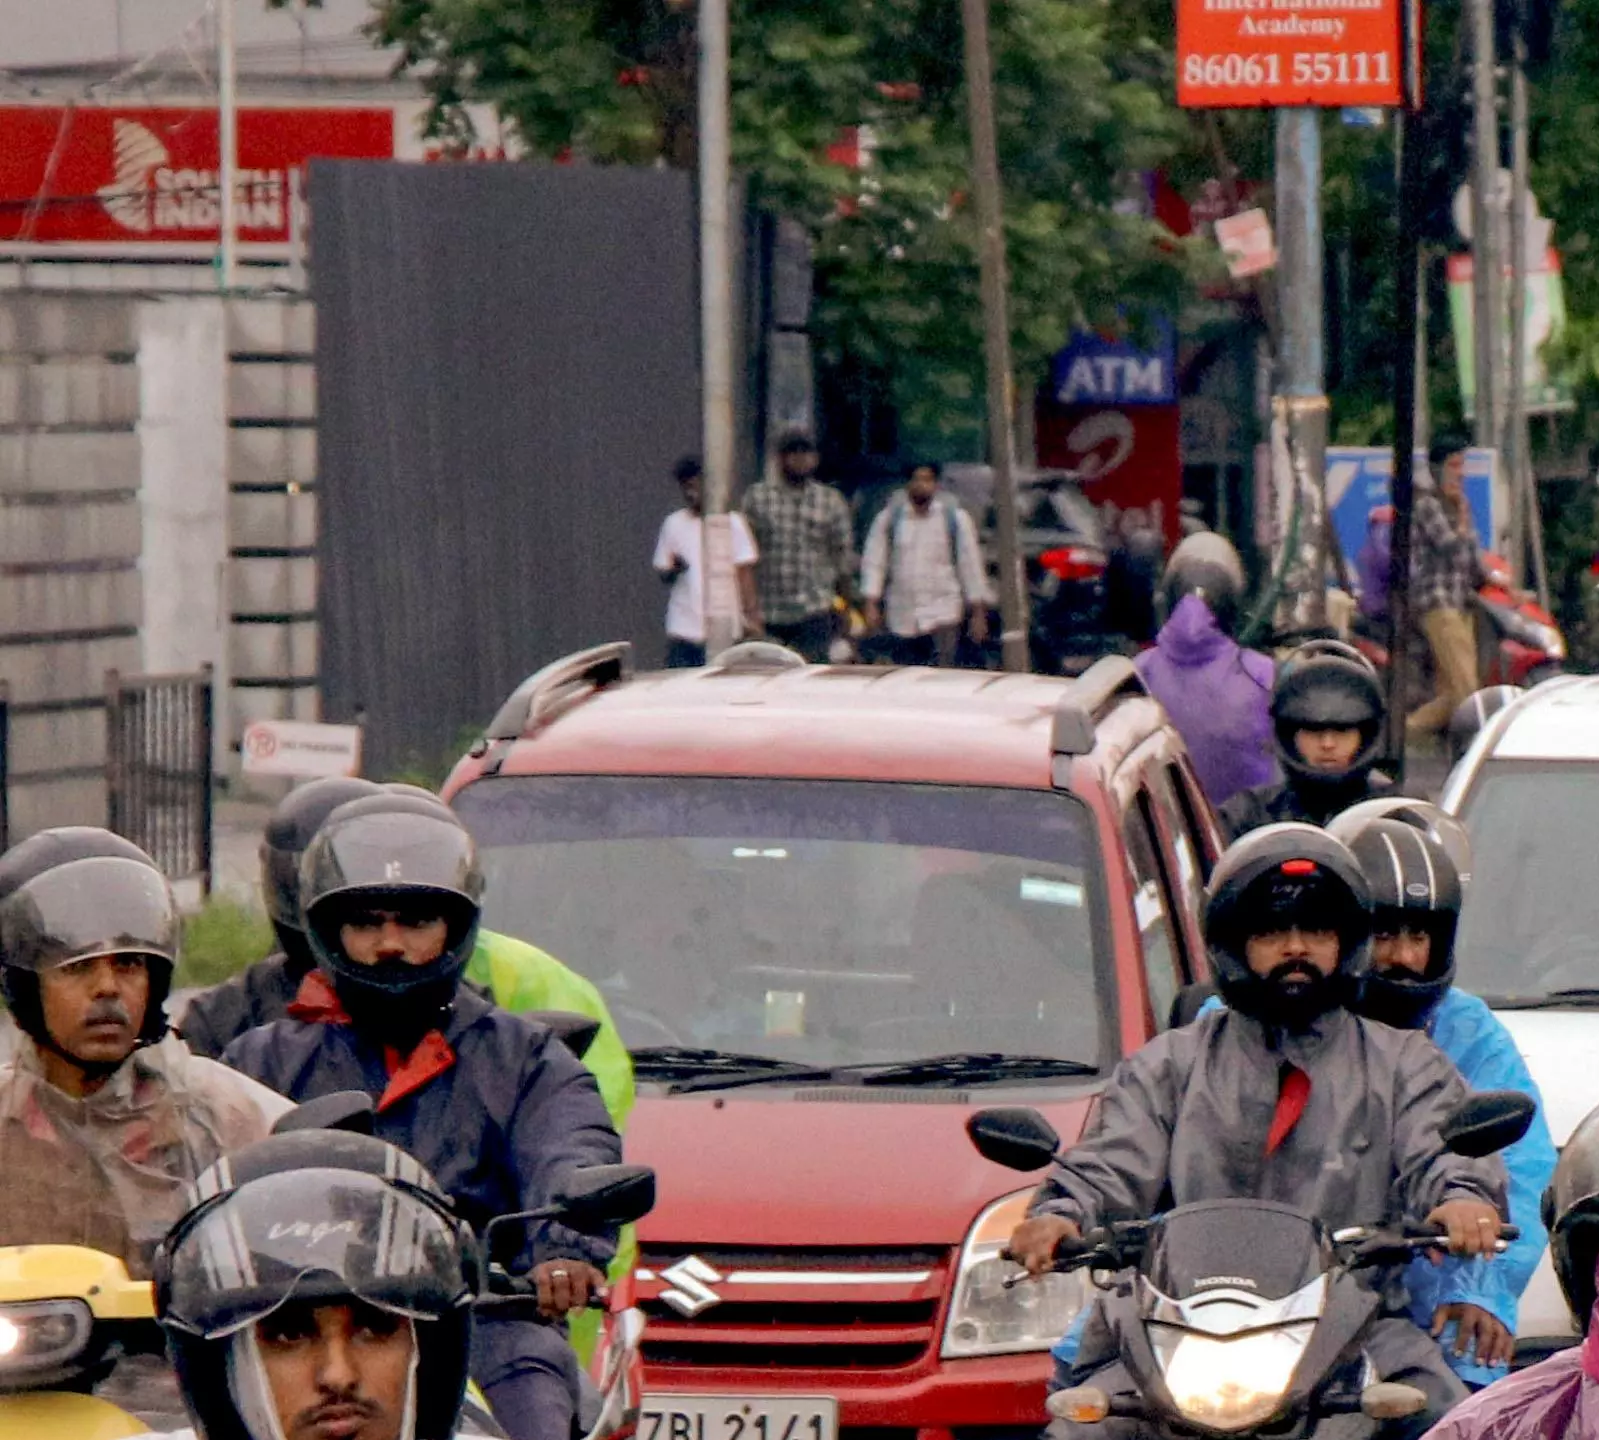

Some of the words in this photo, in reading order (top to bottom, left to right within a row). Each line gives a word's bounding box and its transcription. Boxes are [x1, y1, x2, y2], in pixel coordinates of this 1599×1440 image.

[1238, 14, 1347, 41] Academy
[1183, 52, 1281, 85] 86061
[1292, 51, 1391, 84] 55111
[154, 200, 283, 229] INDAN
[1058, 355, 1163, 402] ATM
[1193, 1276, 1258, 1289] HONDA
